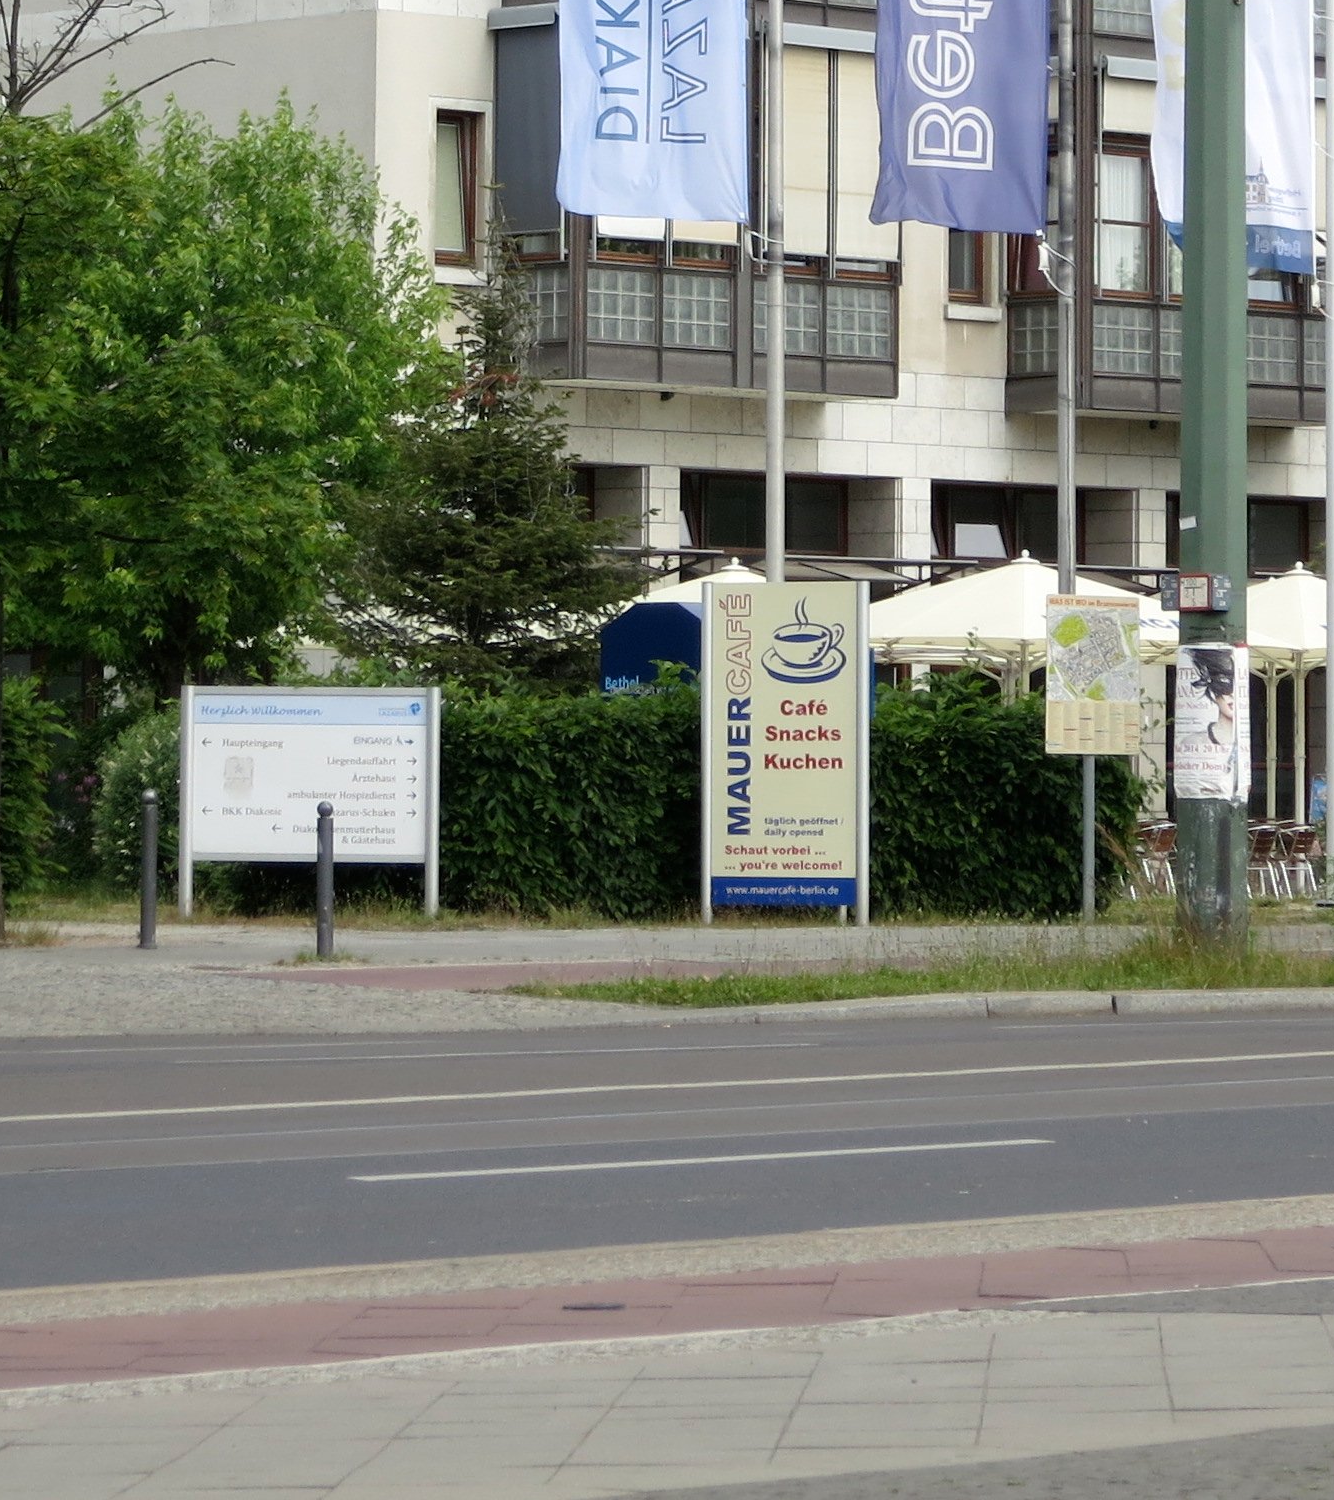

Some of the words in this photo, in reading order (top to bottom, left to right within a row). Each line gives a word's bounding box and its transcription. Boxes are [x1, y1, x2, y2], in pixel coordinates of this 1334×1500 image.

[200, 704, 248, 718] Herzlich
[251, 705, 323, 717] Willkommen
[780, 699, 828, 715] Café
[765, 725, 842, 742] Snacks
[222, 738, 284, 749] Haupteingang
[353, 737, 393, 746] EINGANG
[327, 756, 397, 767] Liegendauffahrt
[764, 753, 843, 770] Kuchen
[339, 790, 396, 801] Hospizdienst
[222, 807, 242, 816] BKK
[764, 817, 796, 827] täglich
[799, 817, 838, 827] geöffnet
[764, 828, 787, 838] daily
[789, 828, 824, 838] opened
[725, 845, 768, 855] Schaut
[772, 845, 811, 855] vorbei
[740, 860, 778, 872] you're
[782, 860, 842, 871] welcome!
